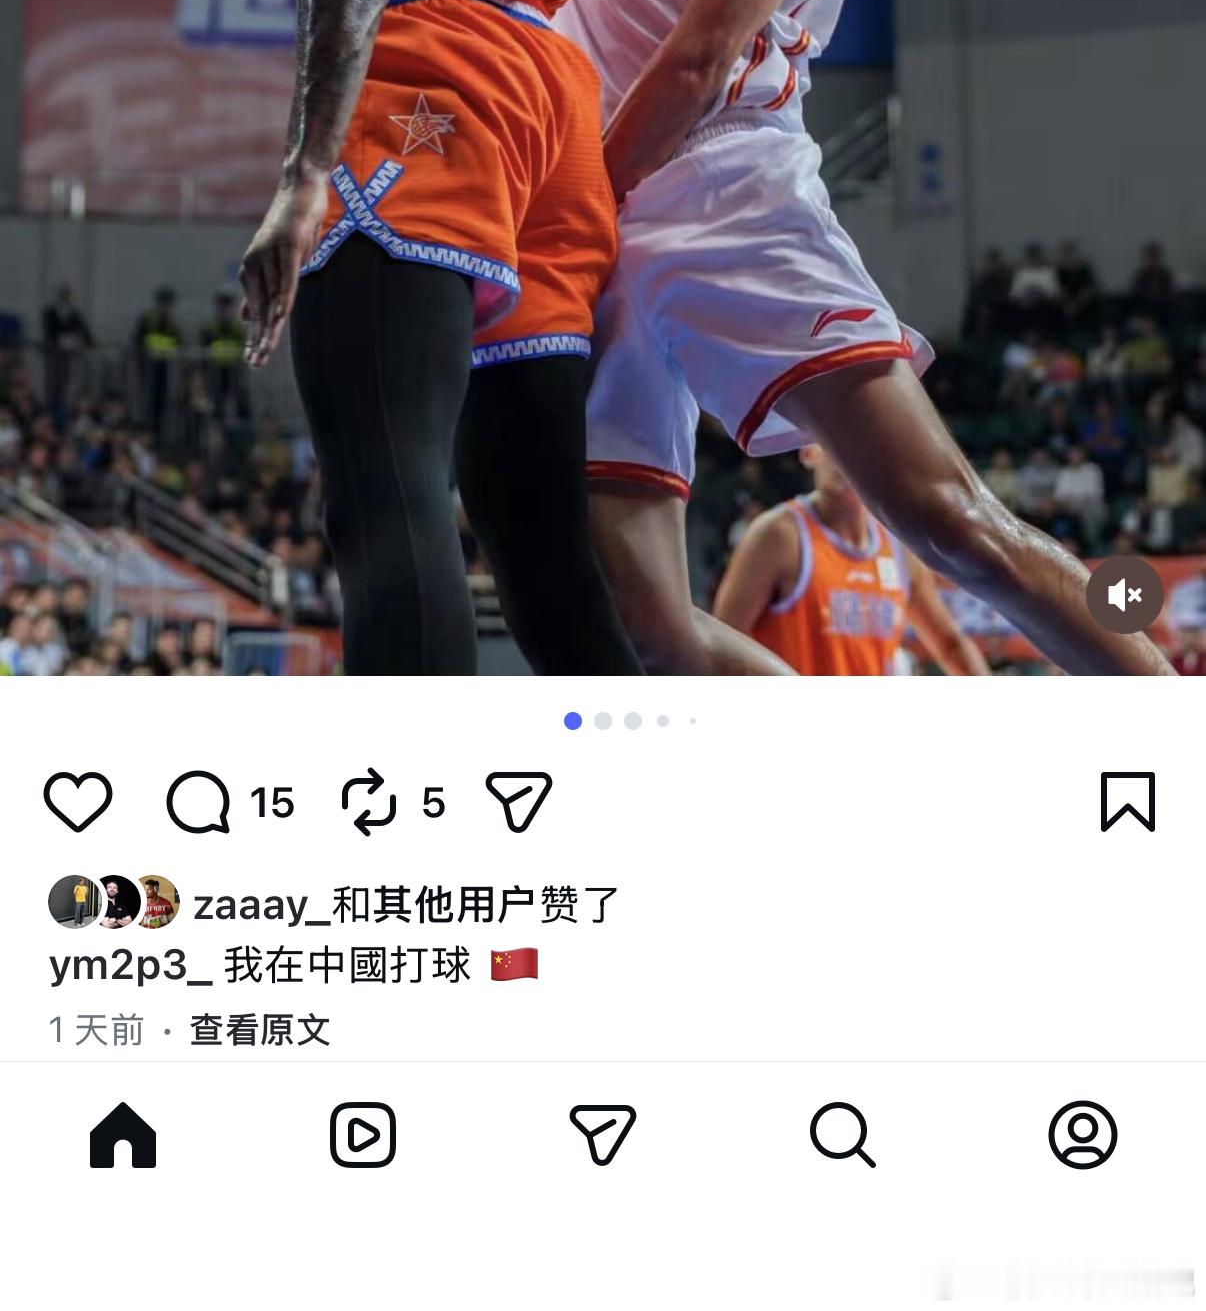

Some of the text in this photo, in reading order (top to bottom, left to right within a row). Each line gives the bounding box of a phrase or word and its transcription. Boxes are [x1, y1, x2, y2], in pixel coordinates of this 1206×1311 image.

[251, 786, 295, 819] 15
[422, 786, 446, 819] 5
[49, 944, 471, 988] ym2p3_ 我在中國打球
[49, 1012, 330, 1047] 1 天前 查看原文
